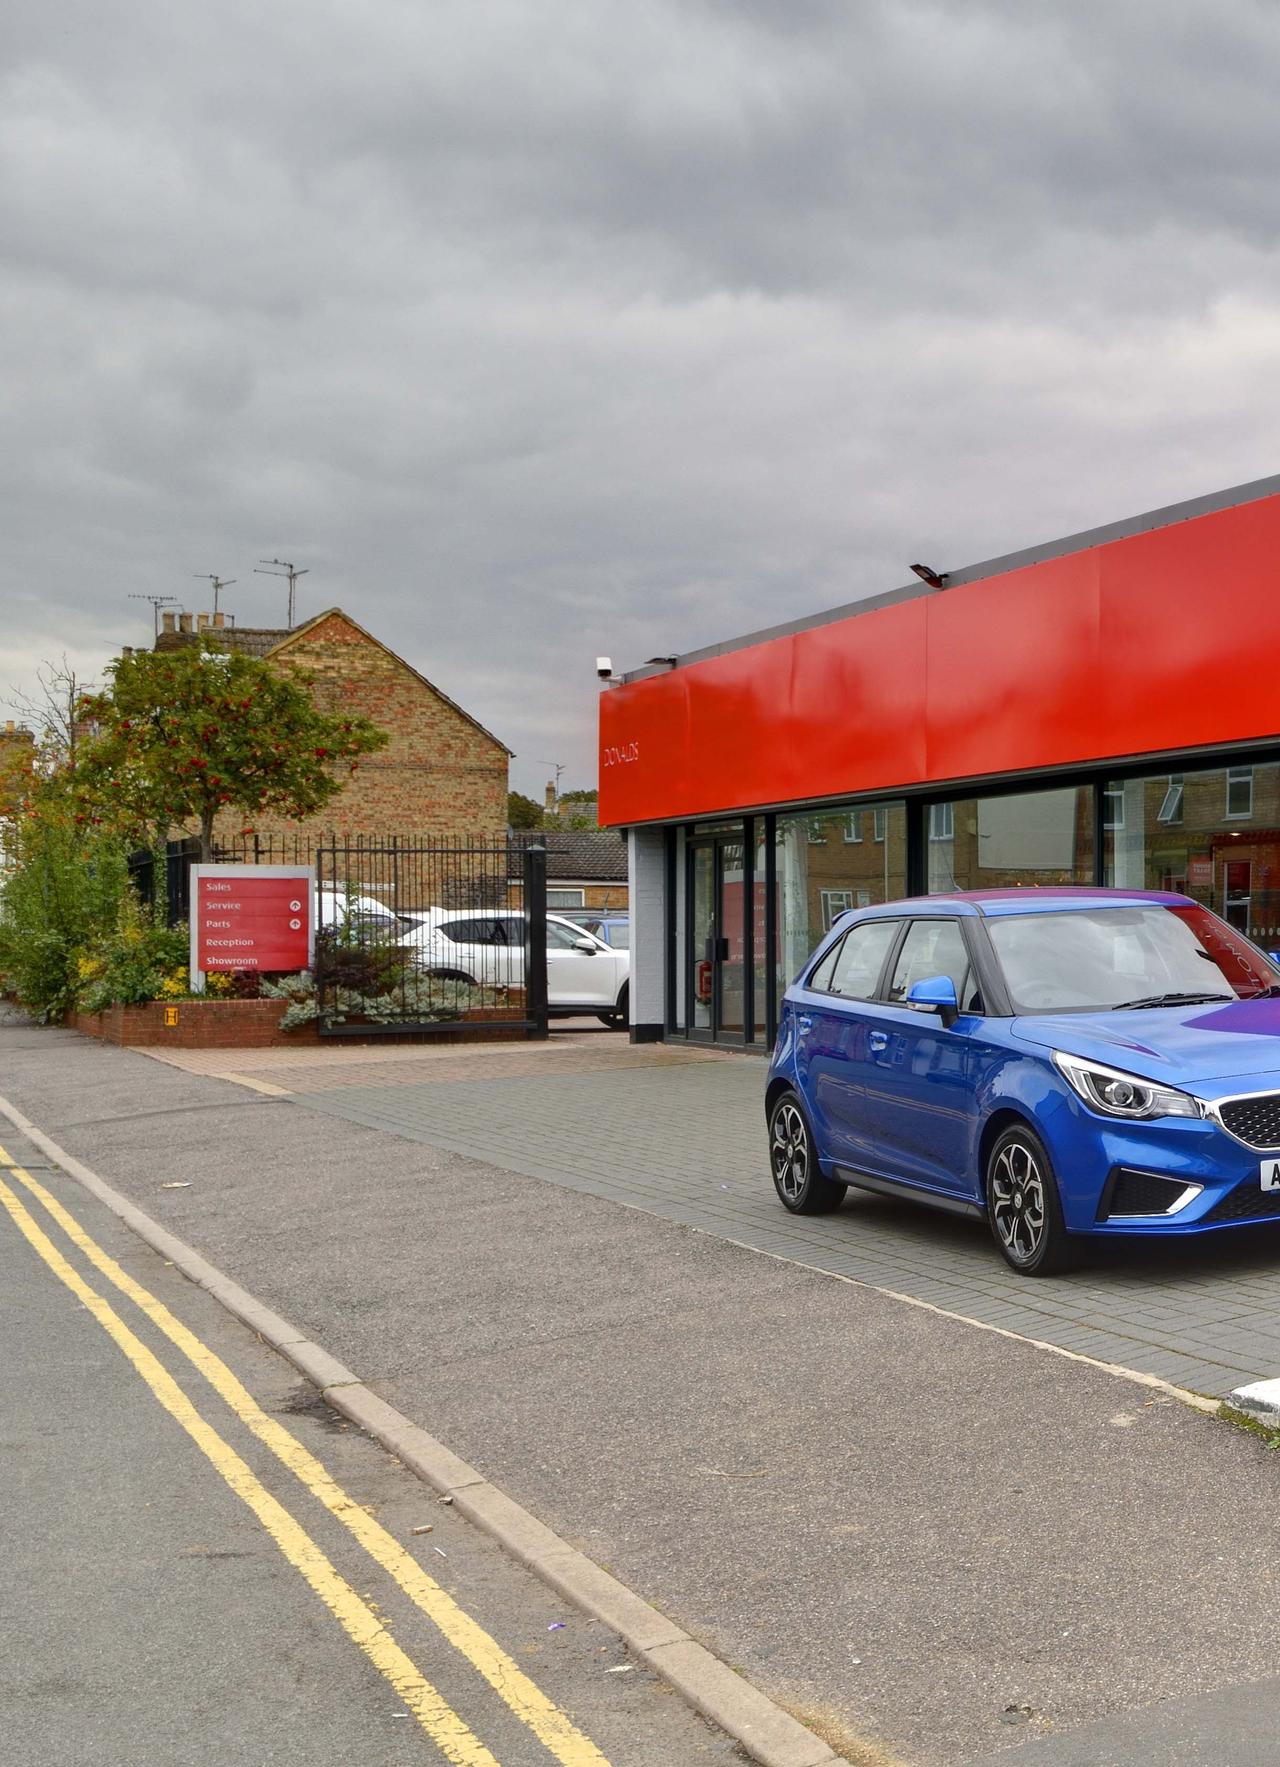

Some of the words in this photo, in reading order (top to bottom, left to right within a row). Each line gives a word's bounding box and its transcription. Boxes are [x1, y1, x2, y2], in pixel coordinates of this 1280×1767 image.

[206, 882, 231, 892] Sales
[206, 901, 241, 910] Service
[206, 919, 231, 928] Parts
[206, 938, 254, 947] Reception
[206, 957, 258, 965] Showroom
